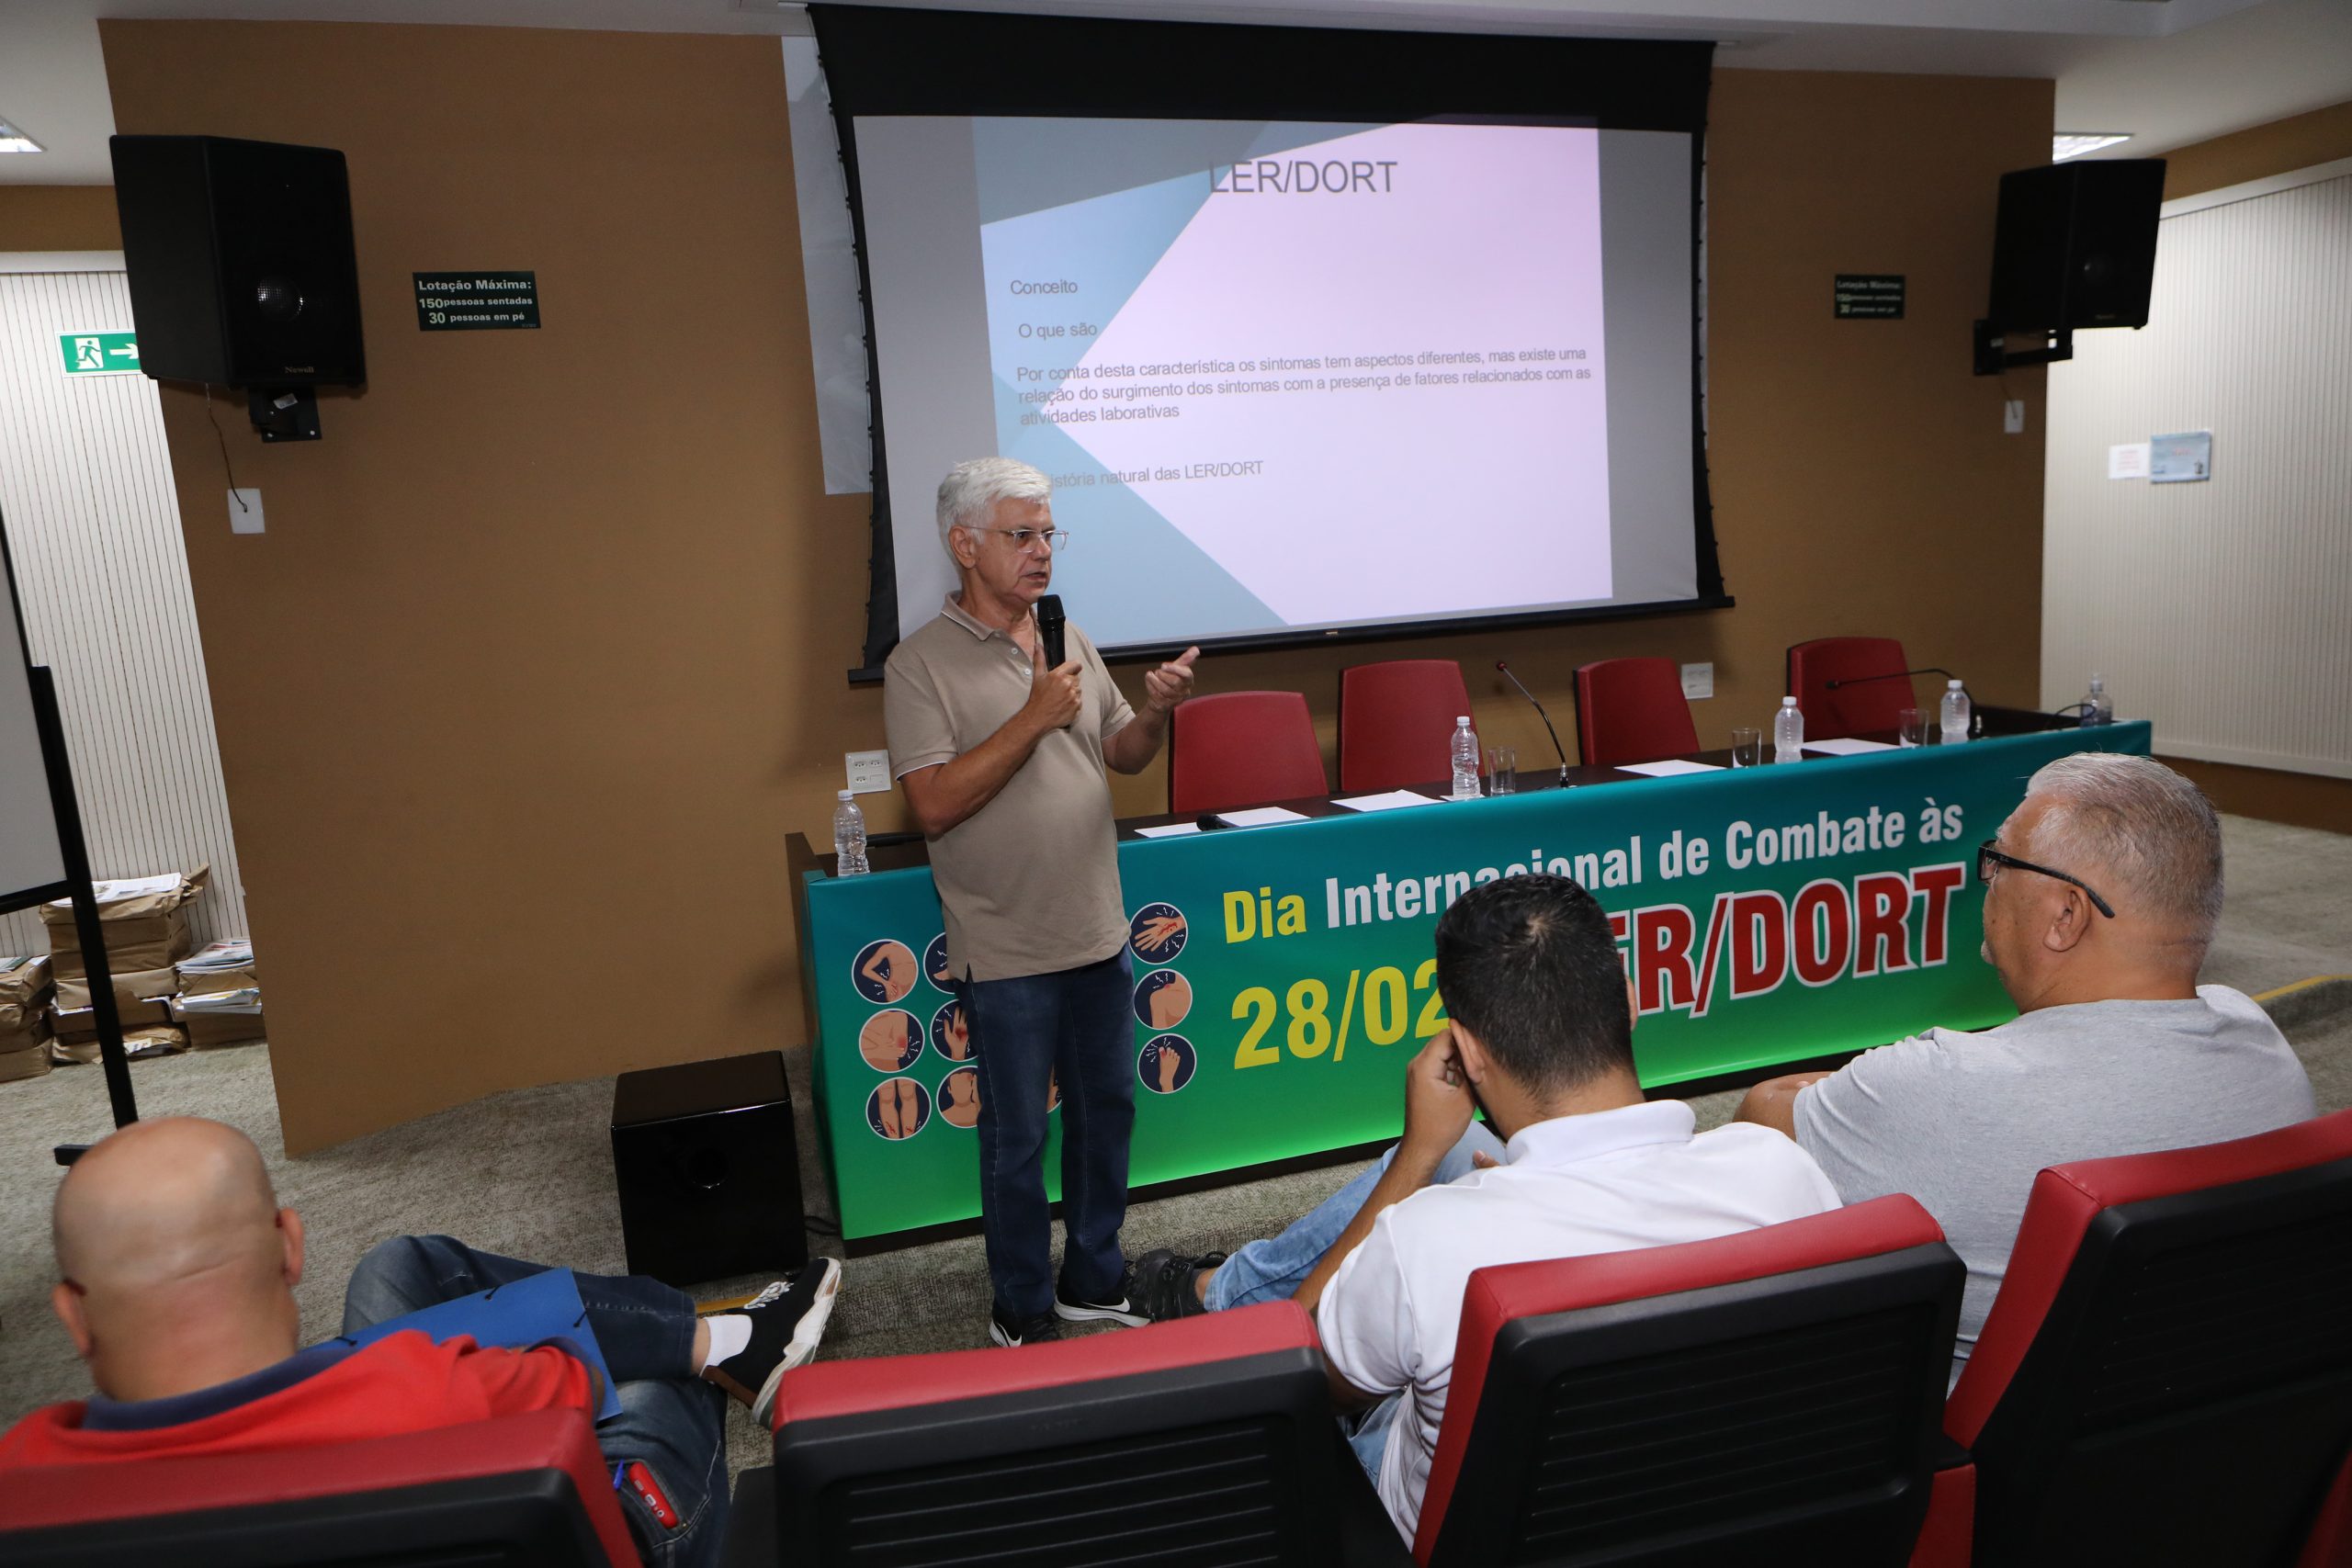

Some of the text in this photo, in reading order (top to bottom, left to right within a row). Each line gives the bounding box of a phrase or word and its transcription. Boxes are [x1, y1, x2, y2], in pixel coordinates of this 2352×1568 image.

[1210, 160, 1397, 193] LER/DORT
[418, 278, 532, 292] Lotação Máxima:
[1011, 278, 1079, 295] Conceito
[487, 297, 533, 306] sentadas
[429, 312, 446, 324] 30
[450, 314, 491, 322] pessoas
[512, 312, 525, 321] pé
[1018, 321, 1098, 341] O que são
[1016, 348, 1587, 382] Por conta desta característica os sintomas tem aspectos diferentes, mas existe uma
[1018, 367, 1591, 406] relação do surgimento dos sintomas com a presença de fatores relacionados com as
[1021, 405, 1180, 426] atividades laborativas
[1050, 460, 1264, 489] istória natural das LER/DORT
[1223, 886, 1306, 944] Dia
[1658, 829, 1710, 880] de
[1725, 807, 1905, 870] Combate
[1918, 796, 1963, 843] às
[1231, 862, 1966, 1070] 28/02 R/DORT
